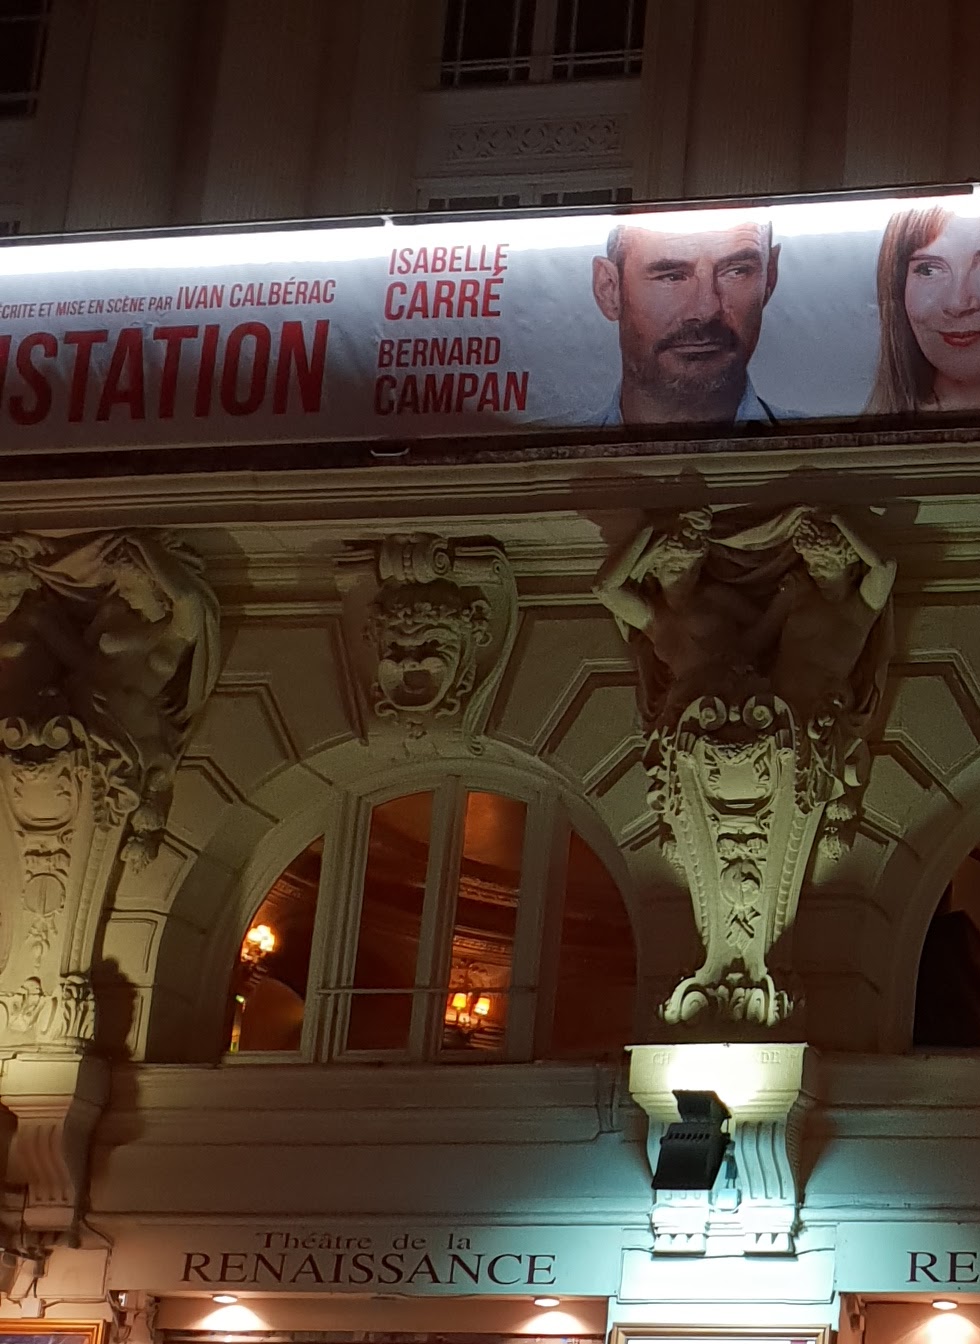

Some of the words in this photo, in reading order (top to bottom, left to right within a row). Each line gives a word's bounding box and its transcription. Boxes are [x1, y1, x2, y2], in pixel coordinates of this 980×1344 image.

[388, 242, 511, 276] ISABELLE
[39, 302, 54, 317] ET
[56, 300, 86, 316] MISE
[88, 299, 104, 314] EN
[106, 293, 145, 314] SCÈNE
[148, 294, 172, 312] PAR
[176, 282, 224, 311] IVAN
[229, 276, 336, 309] CALBÉRAC
[384, 268, 505, 321] CARRÉ
[377, 335, 502, 369] BERNARD
[374, 372, 530, 416] CAMPAN
[254, 1231, 373, 1252] Théâtre
[391, 1232, 427, 1252] de
[447, 1232, 472, 1252] la
[180, 1251, 558, 1287] RENAISSANCE
